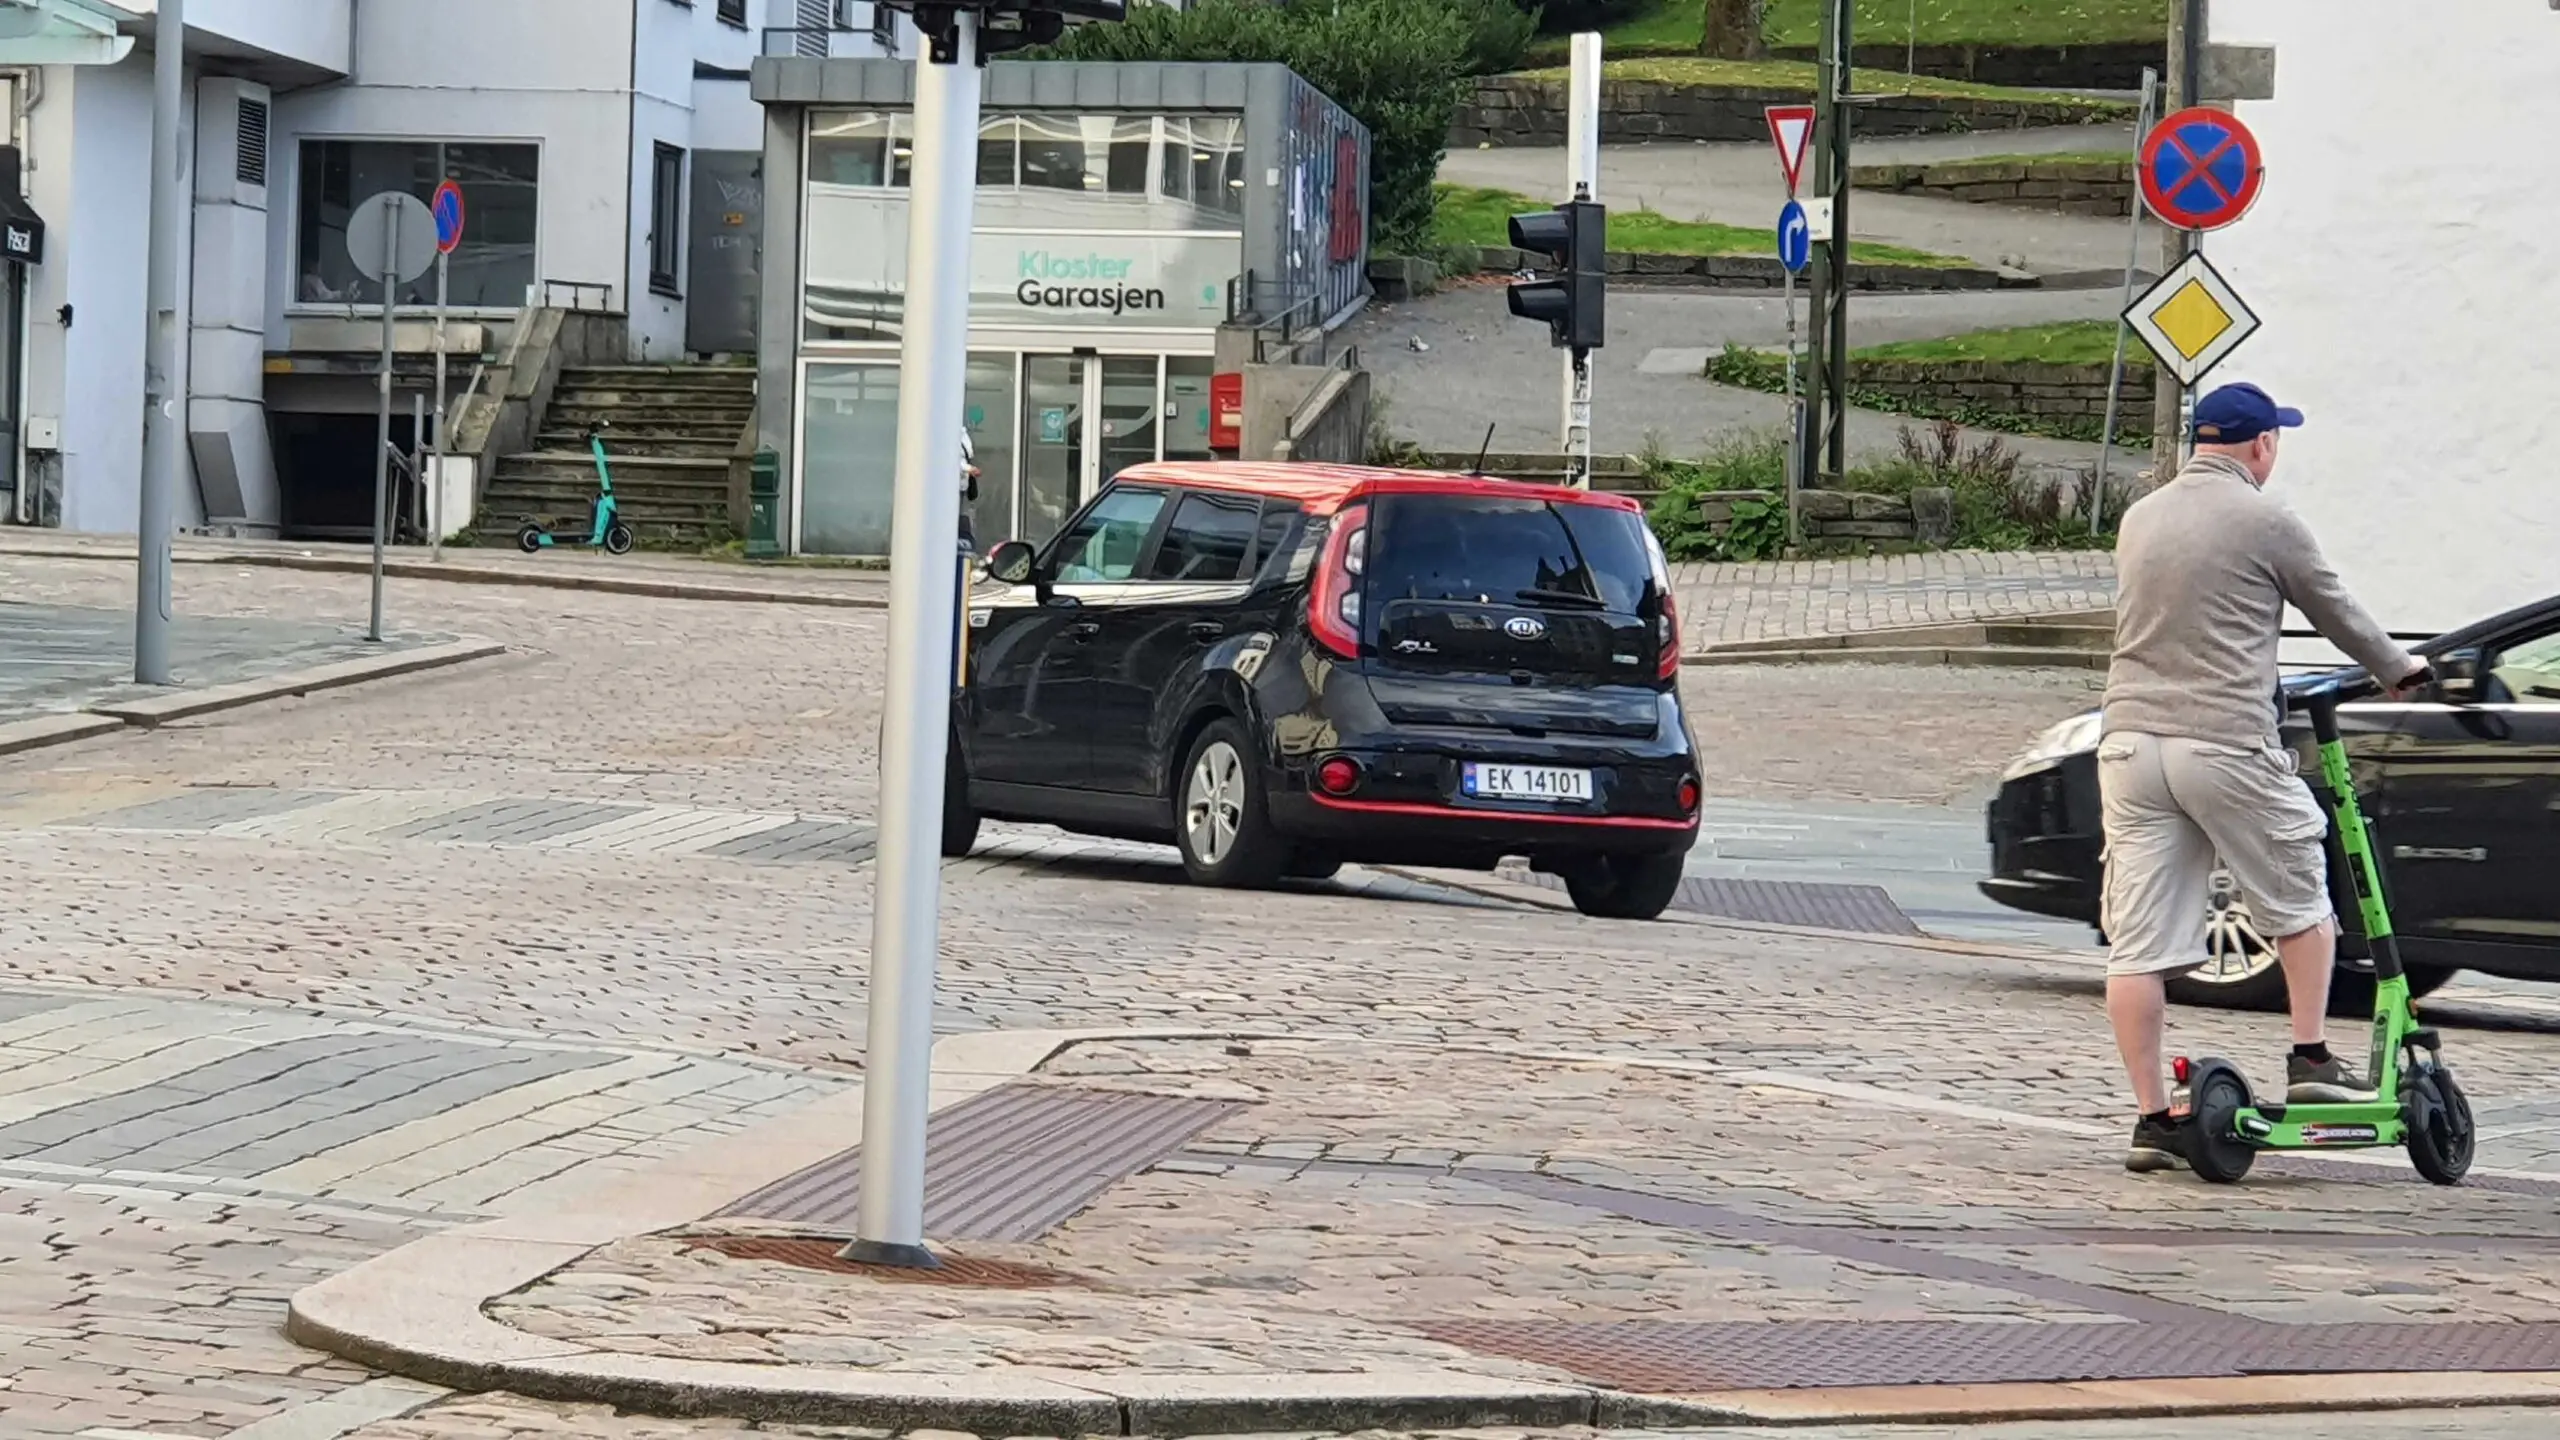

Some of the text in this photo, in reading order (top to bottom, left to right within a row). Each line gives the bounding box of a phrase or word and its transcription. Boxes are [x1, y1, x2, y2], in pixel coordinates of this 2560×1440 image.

[1019, 250, 1132, 279] Kloster
[1017, 279, 1164, 315] Garasjen
[1487, 768, 1581, 794] EK 14101
